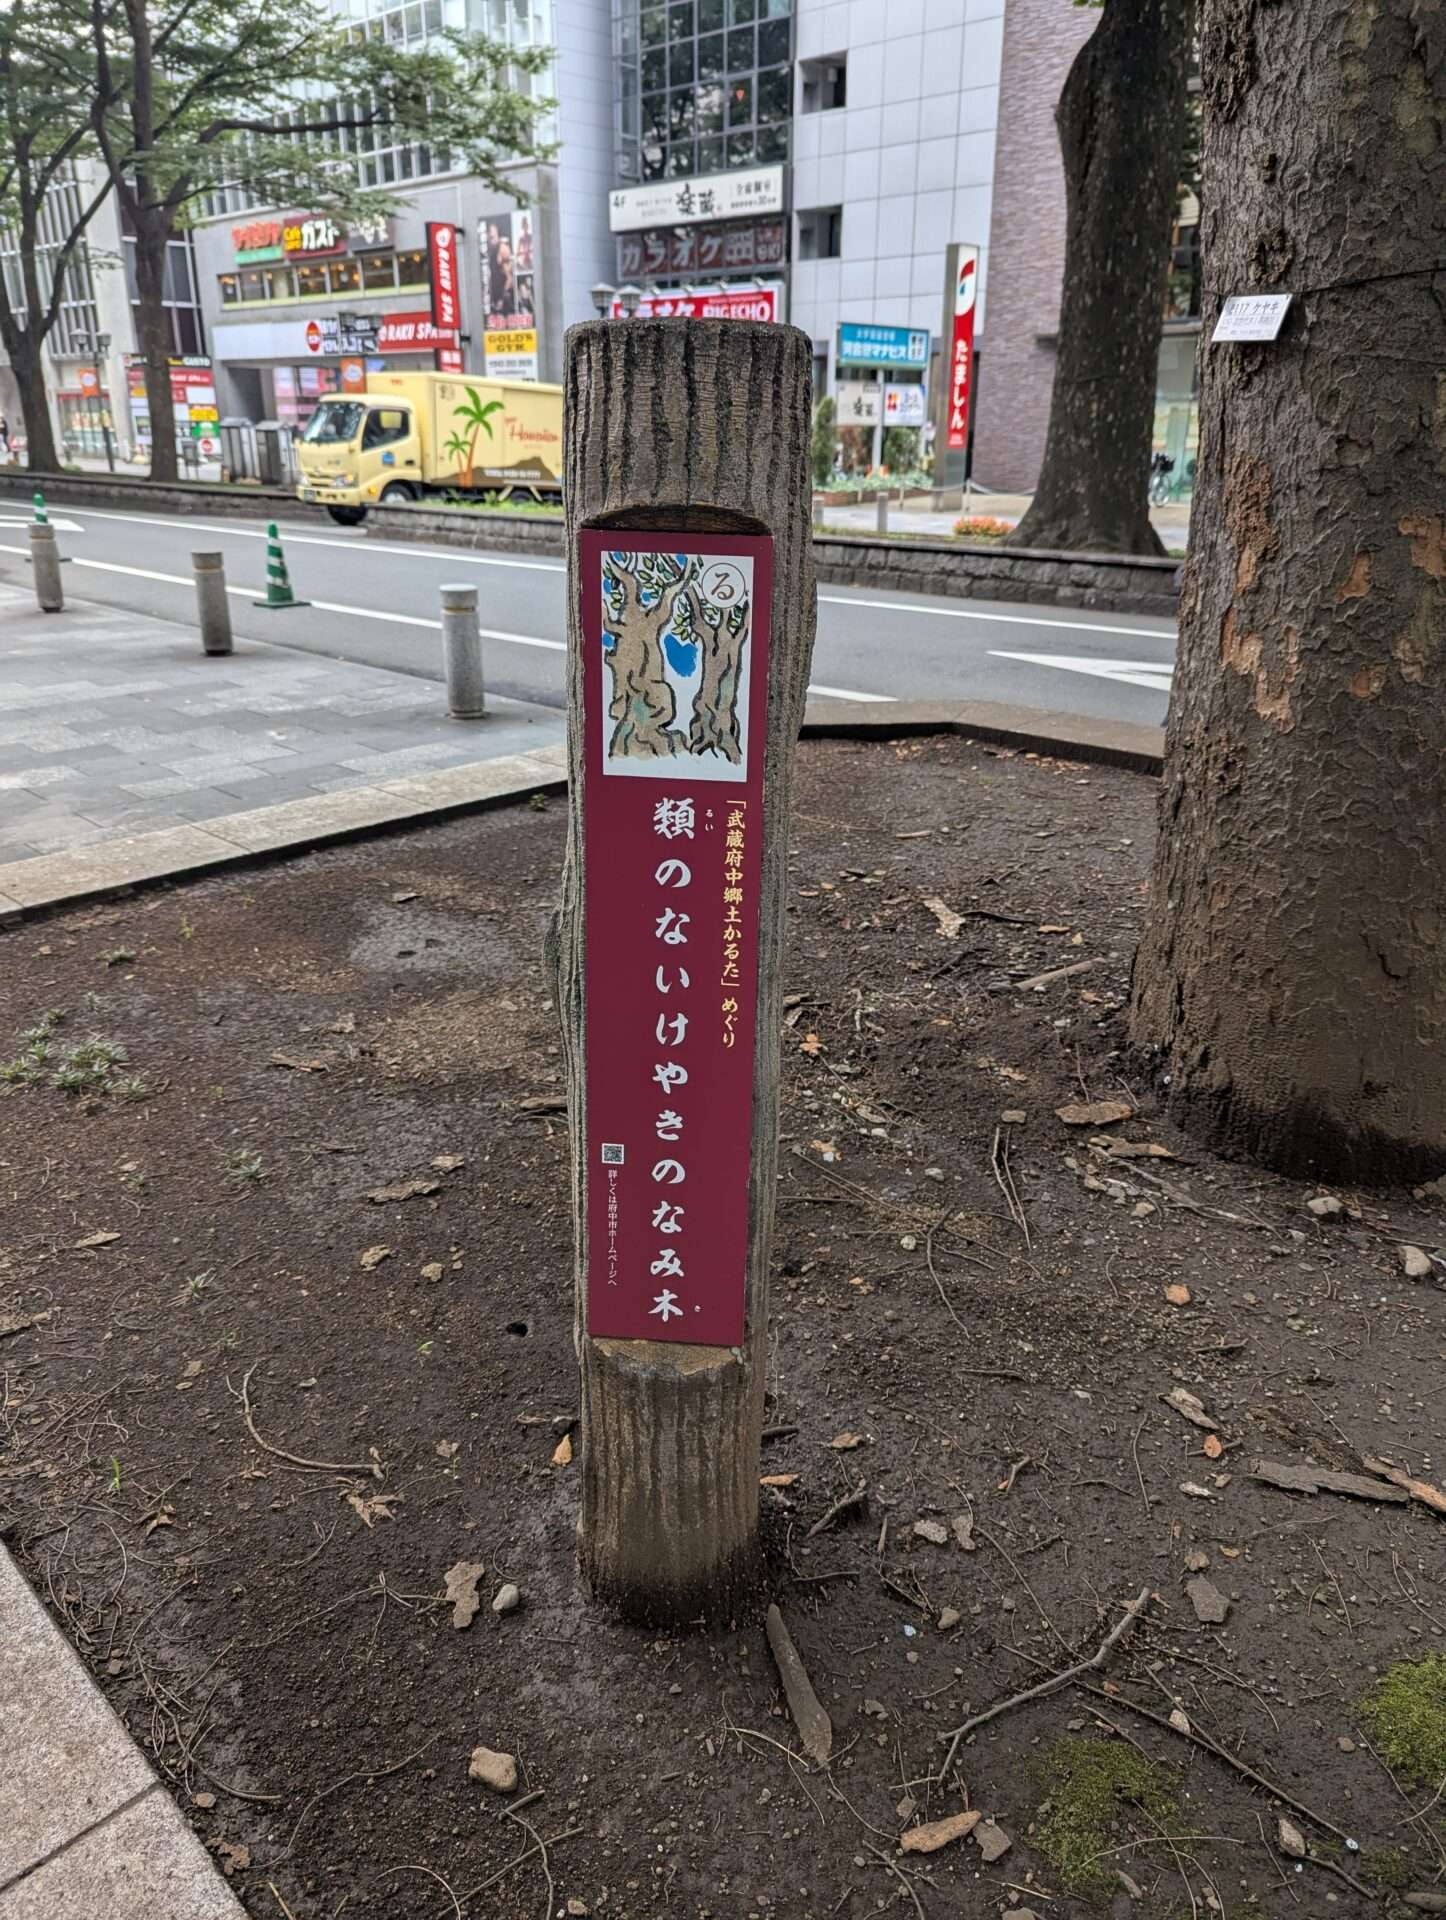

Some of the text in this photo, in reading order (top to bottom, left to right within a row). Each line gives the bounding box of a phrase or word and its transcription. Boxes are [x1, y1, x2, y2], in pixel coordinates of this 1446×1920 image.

[438, 248, 452, 291] RAKU
[441, 292, 454, 323] SPA
[388, 323, 416, 341] RAKU
[416, 322, 438, 339] SPA
[487, 333, 534, 344] GOLD'S
[496, 344, 527, 353] GYM
[951, 339, 969, 430] たましん
[710, 572, 735, 601] る
[704, 808, 714, 832] るい
[720, 799, 747, 1049] 「武蔵府中郷土かるた」 めぐり
[648, 796, 696, 1323] 類のないけやきのなみ木
[607, 1169, 619, 1286] 詳しくは府中市ホームページへ
